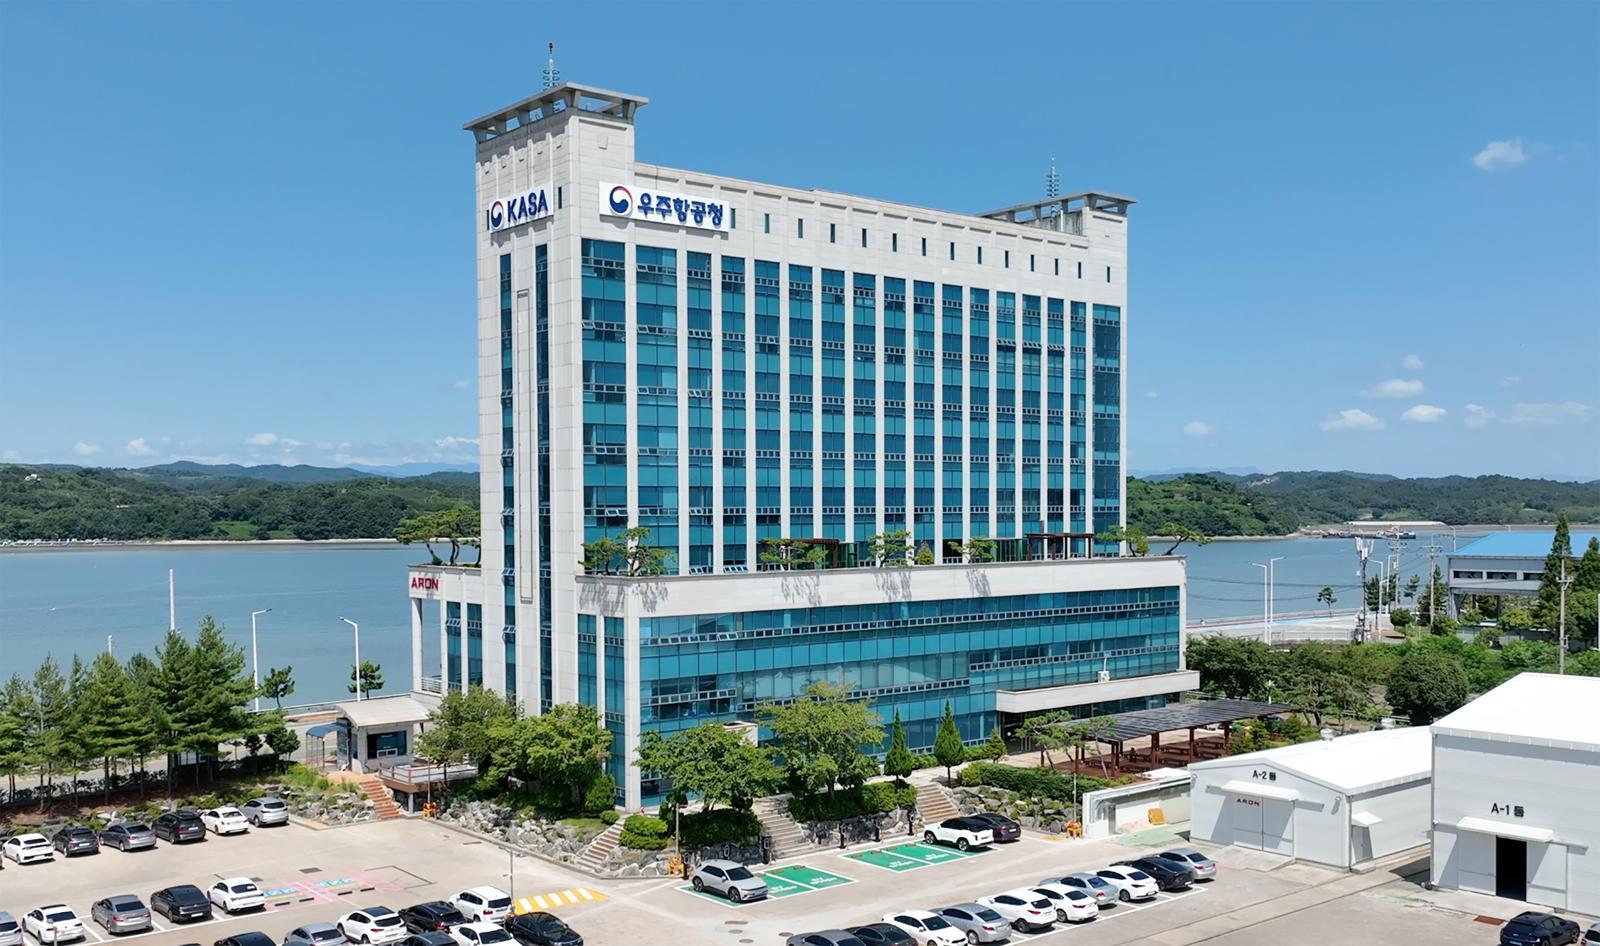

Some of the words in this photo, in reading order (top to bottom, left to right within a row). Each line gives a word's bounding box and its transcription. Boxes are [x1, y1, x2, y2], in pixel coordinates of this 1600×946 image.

[508, 189, 548, 222] KASA
[638, 192, 724, 227] 우주항공청
[411, 577, 438, 590] ARON
[1236, 798, 1260, 806] ARON
